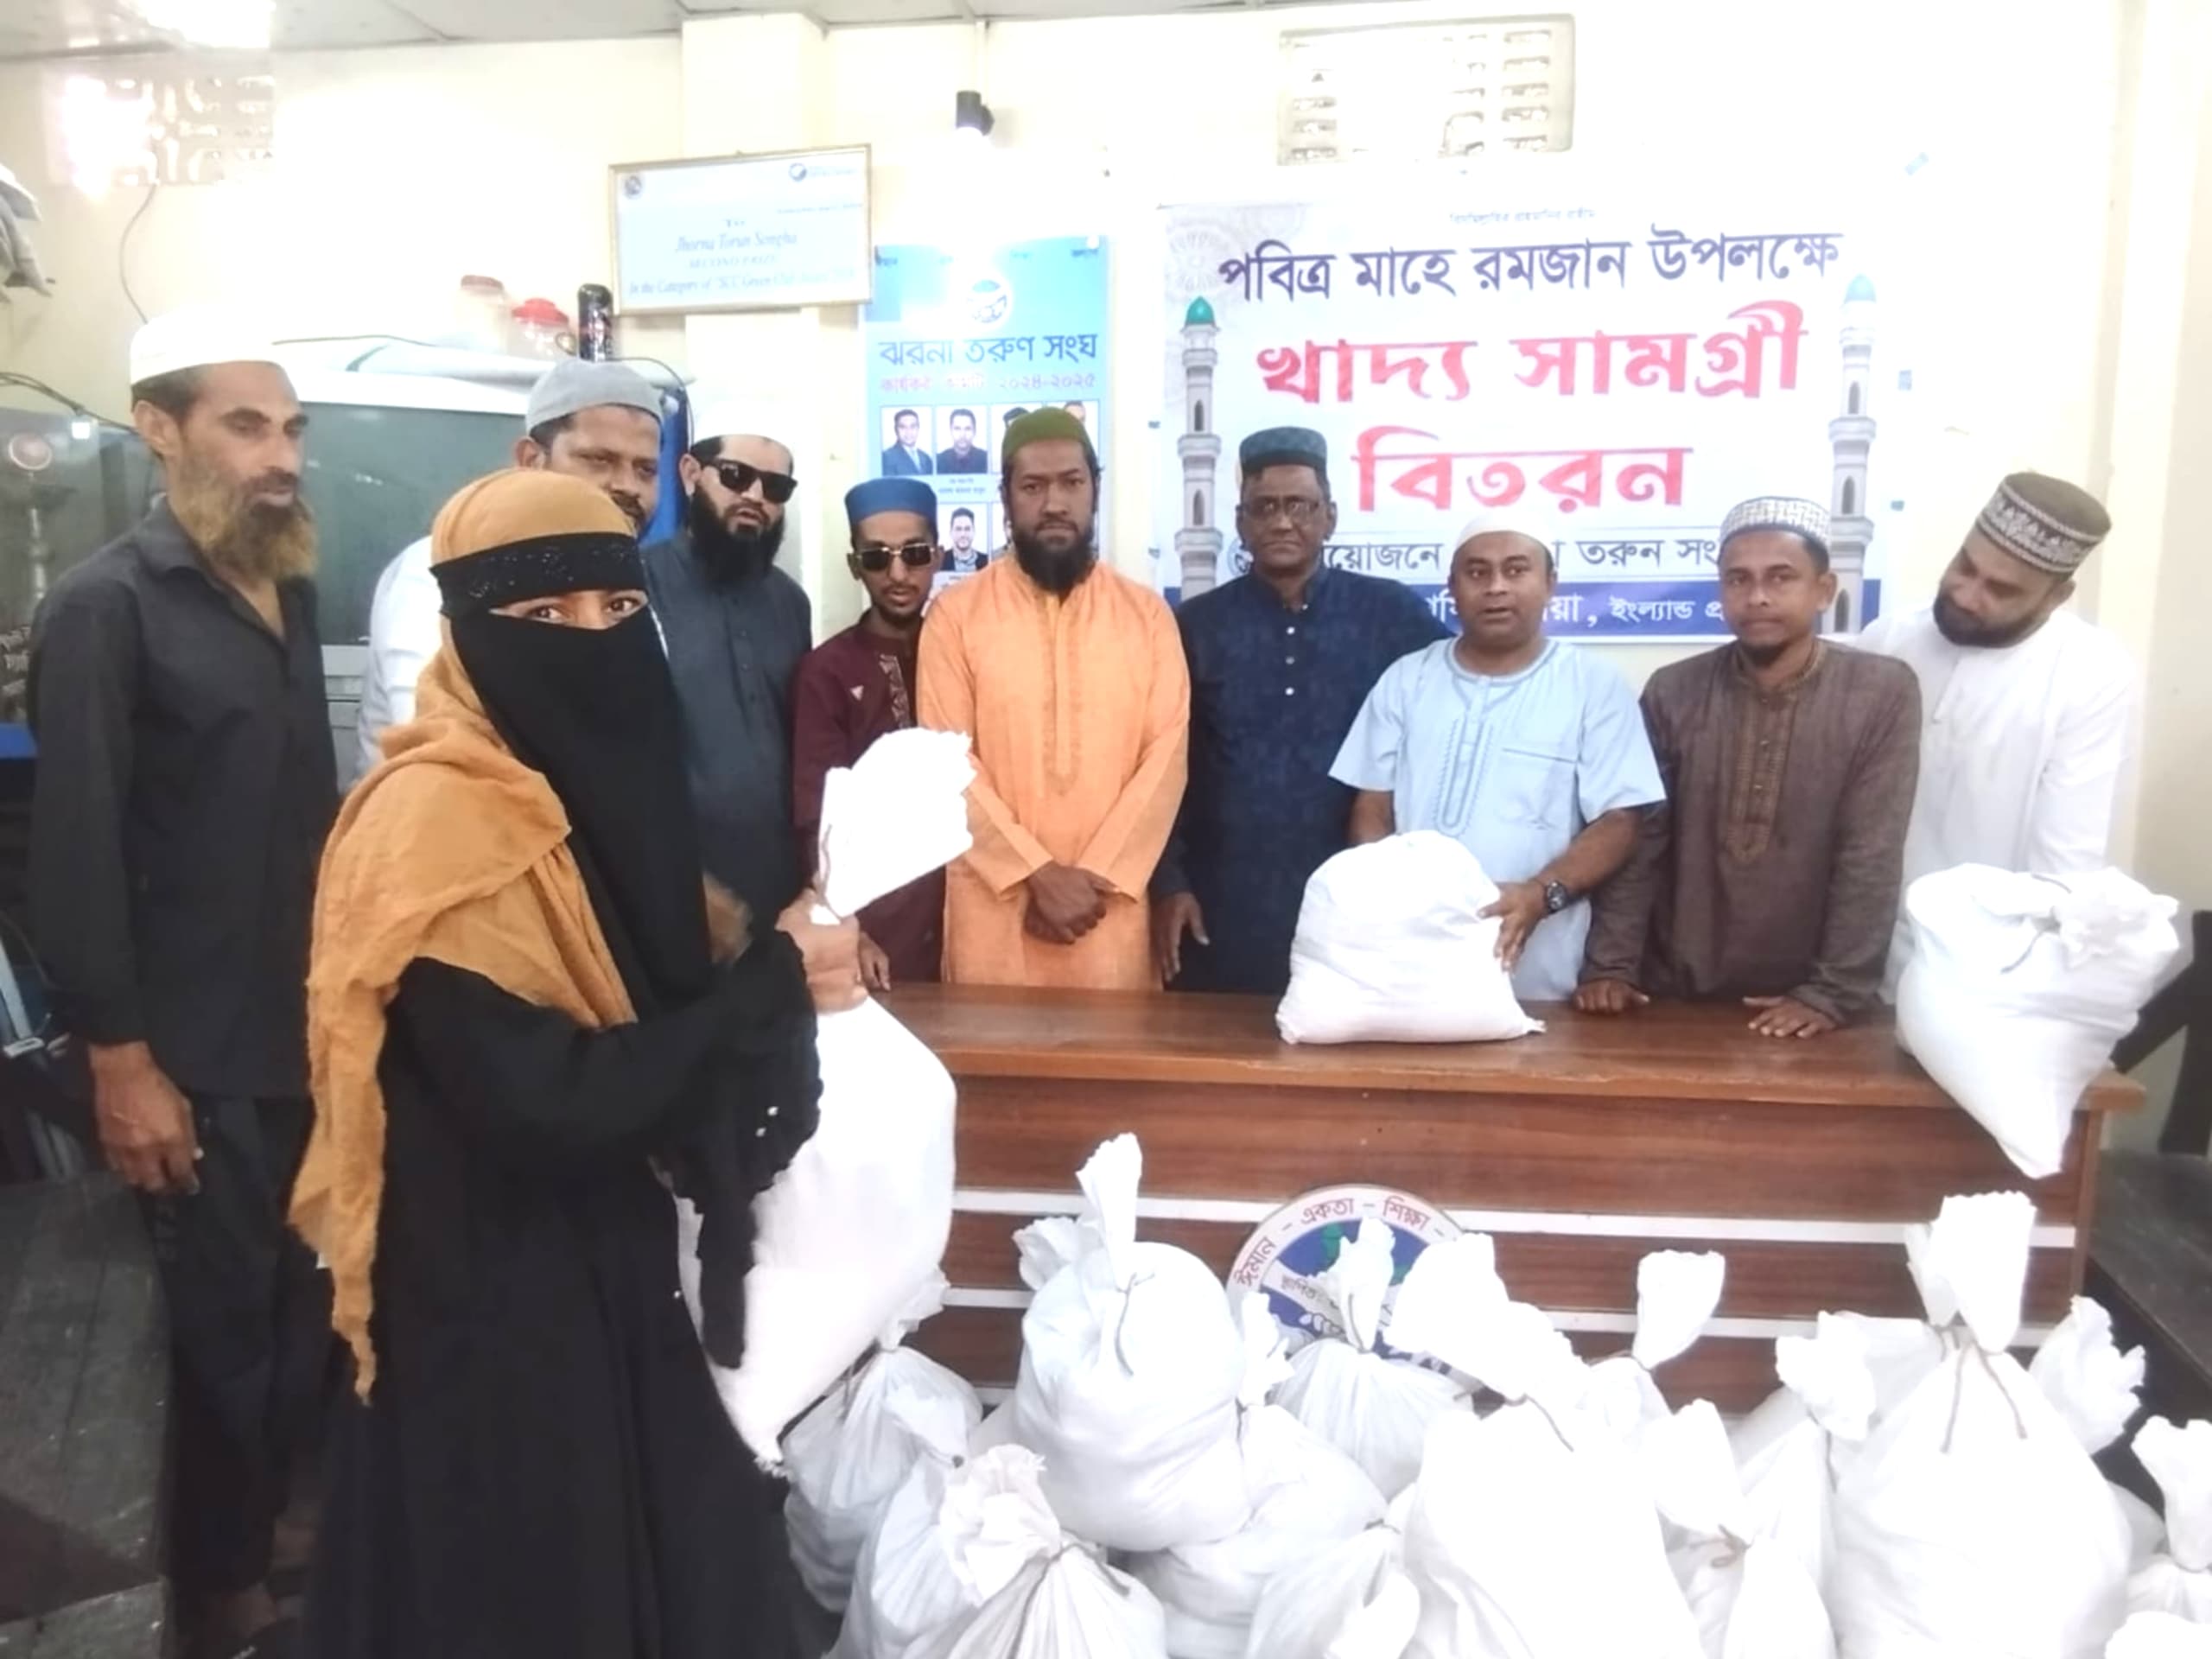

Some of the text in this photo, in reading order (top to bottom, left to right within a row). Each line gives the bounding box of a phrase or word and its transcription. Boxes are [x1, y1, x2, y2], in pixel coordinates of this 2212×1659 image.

[1219, 223, 1844, 302] পবিত্র মাহে রমজান উপলক্ষে
[878, 333, 1099, 366] ঝরনা তরুণ সংঘ
[1255, 300, 1808, 404] খাদ্য সামগ্রী
[1351, 425, 1694, 513] বিতরন
[1323, 541, 1446, 574] য়োজনে
[1575, 538, 1665, 568] তরুন
[1675, 537, 1720, 567] সং
[1300, 1198, 1354, 1224] একতা
[1382, 1194, 1431, 1231] শিক্ষা
